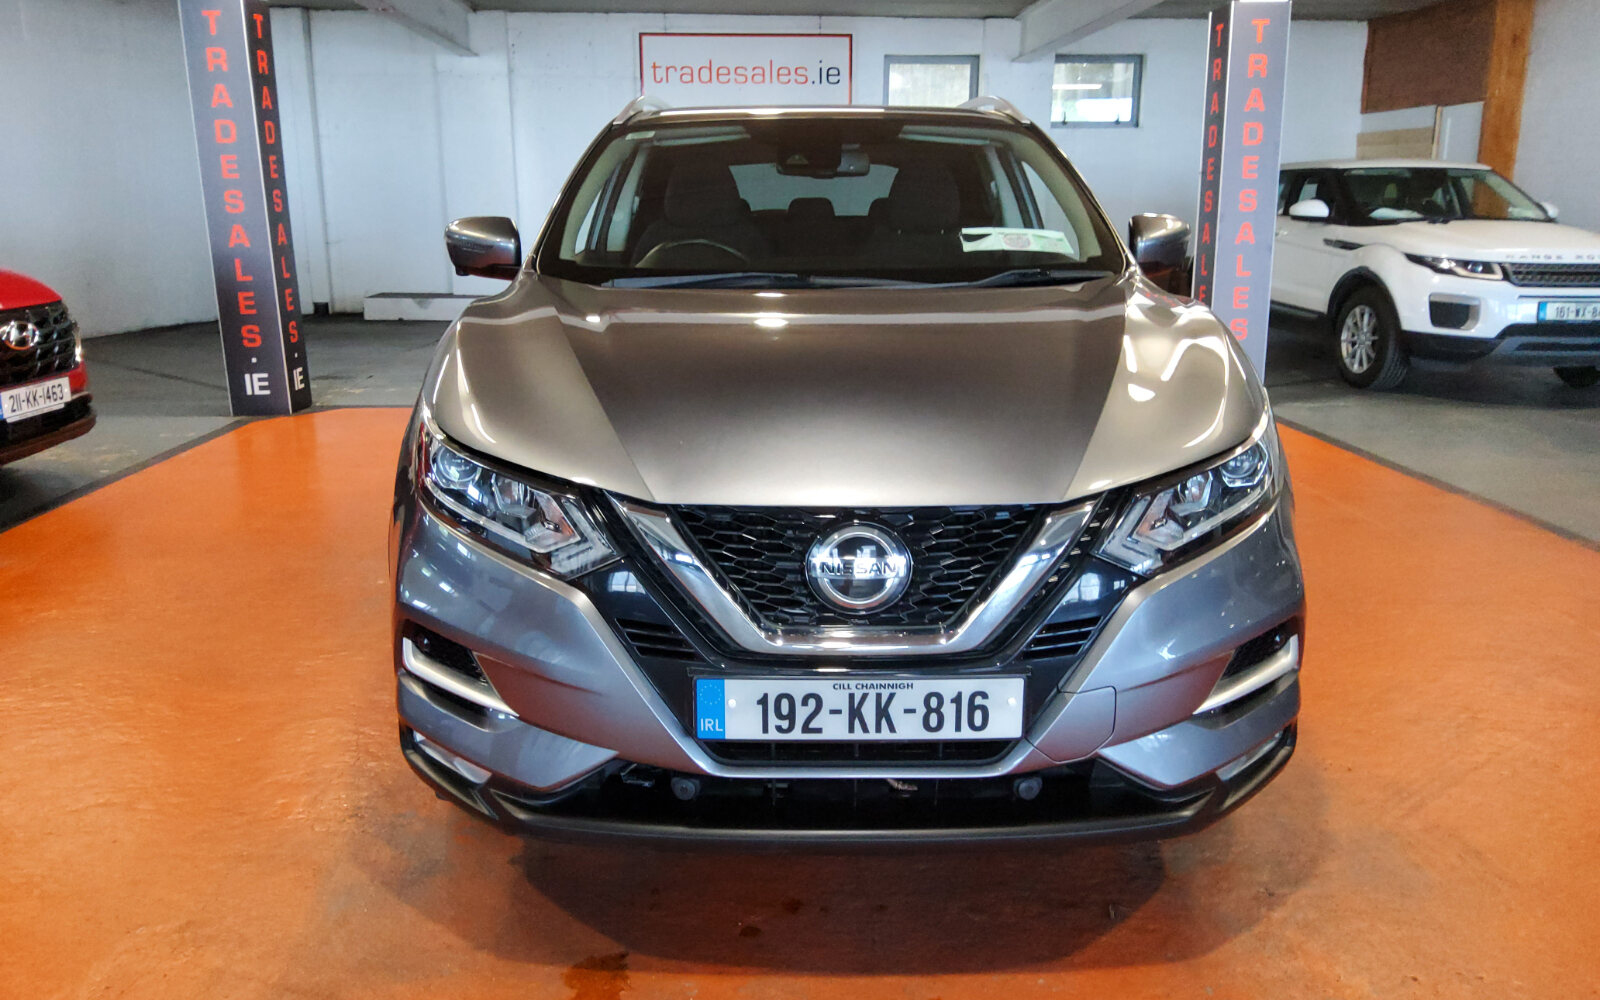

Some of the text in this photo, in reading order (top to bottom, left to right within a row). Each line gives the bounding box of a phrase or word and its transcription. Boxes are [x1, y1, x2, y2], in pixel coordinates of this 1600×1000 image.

[651, 59, 841, 85] tradesales.ie
[9, 383, 64, 413] 211-KK-1463
[821, 562, 897, 576] NISSAN
[832, 682, 914, 691] CILL CHAINNIGH
[756, 690, 990, 735] 192-KK-816
[700, 718, 723, 732] IRL
